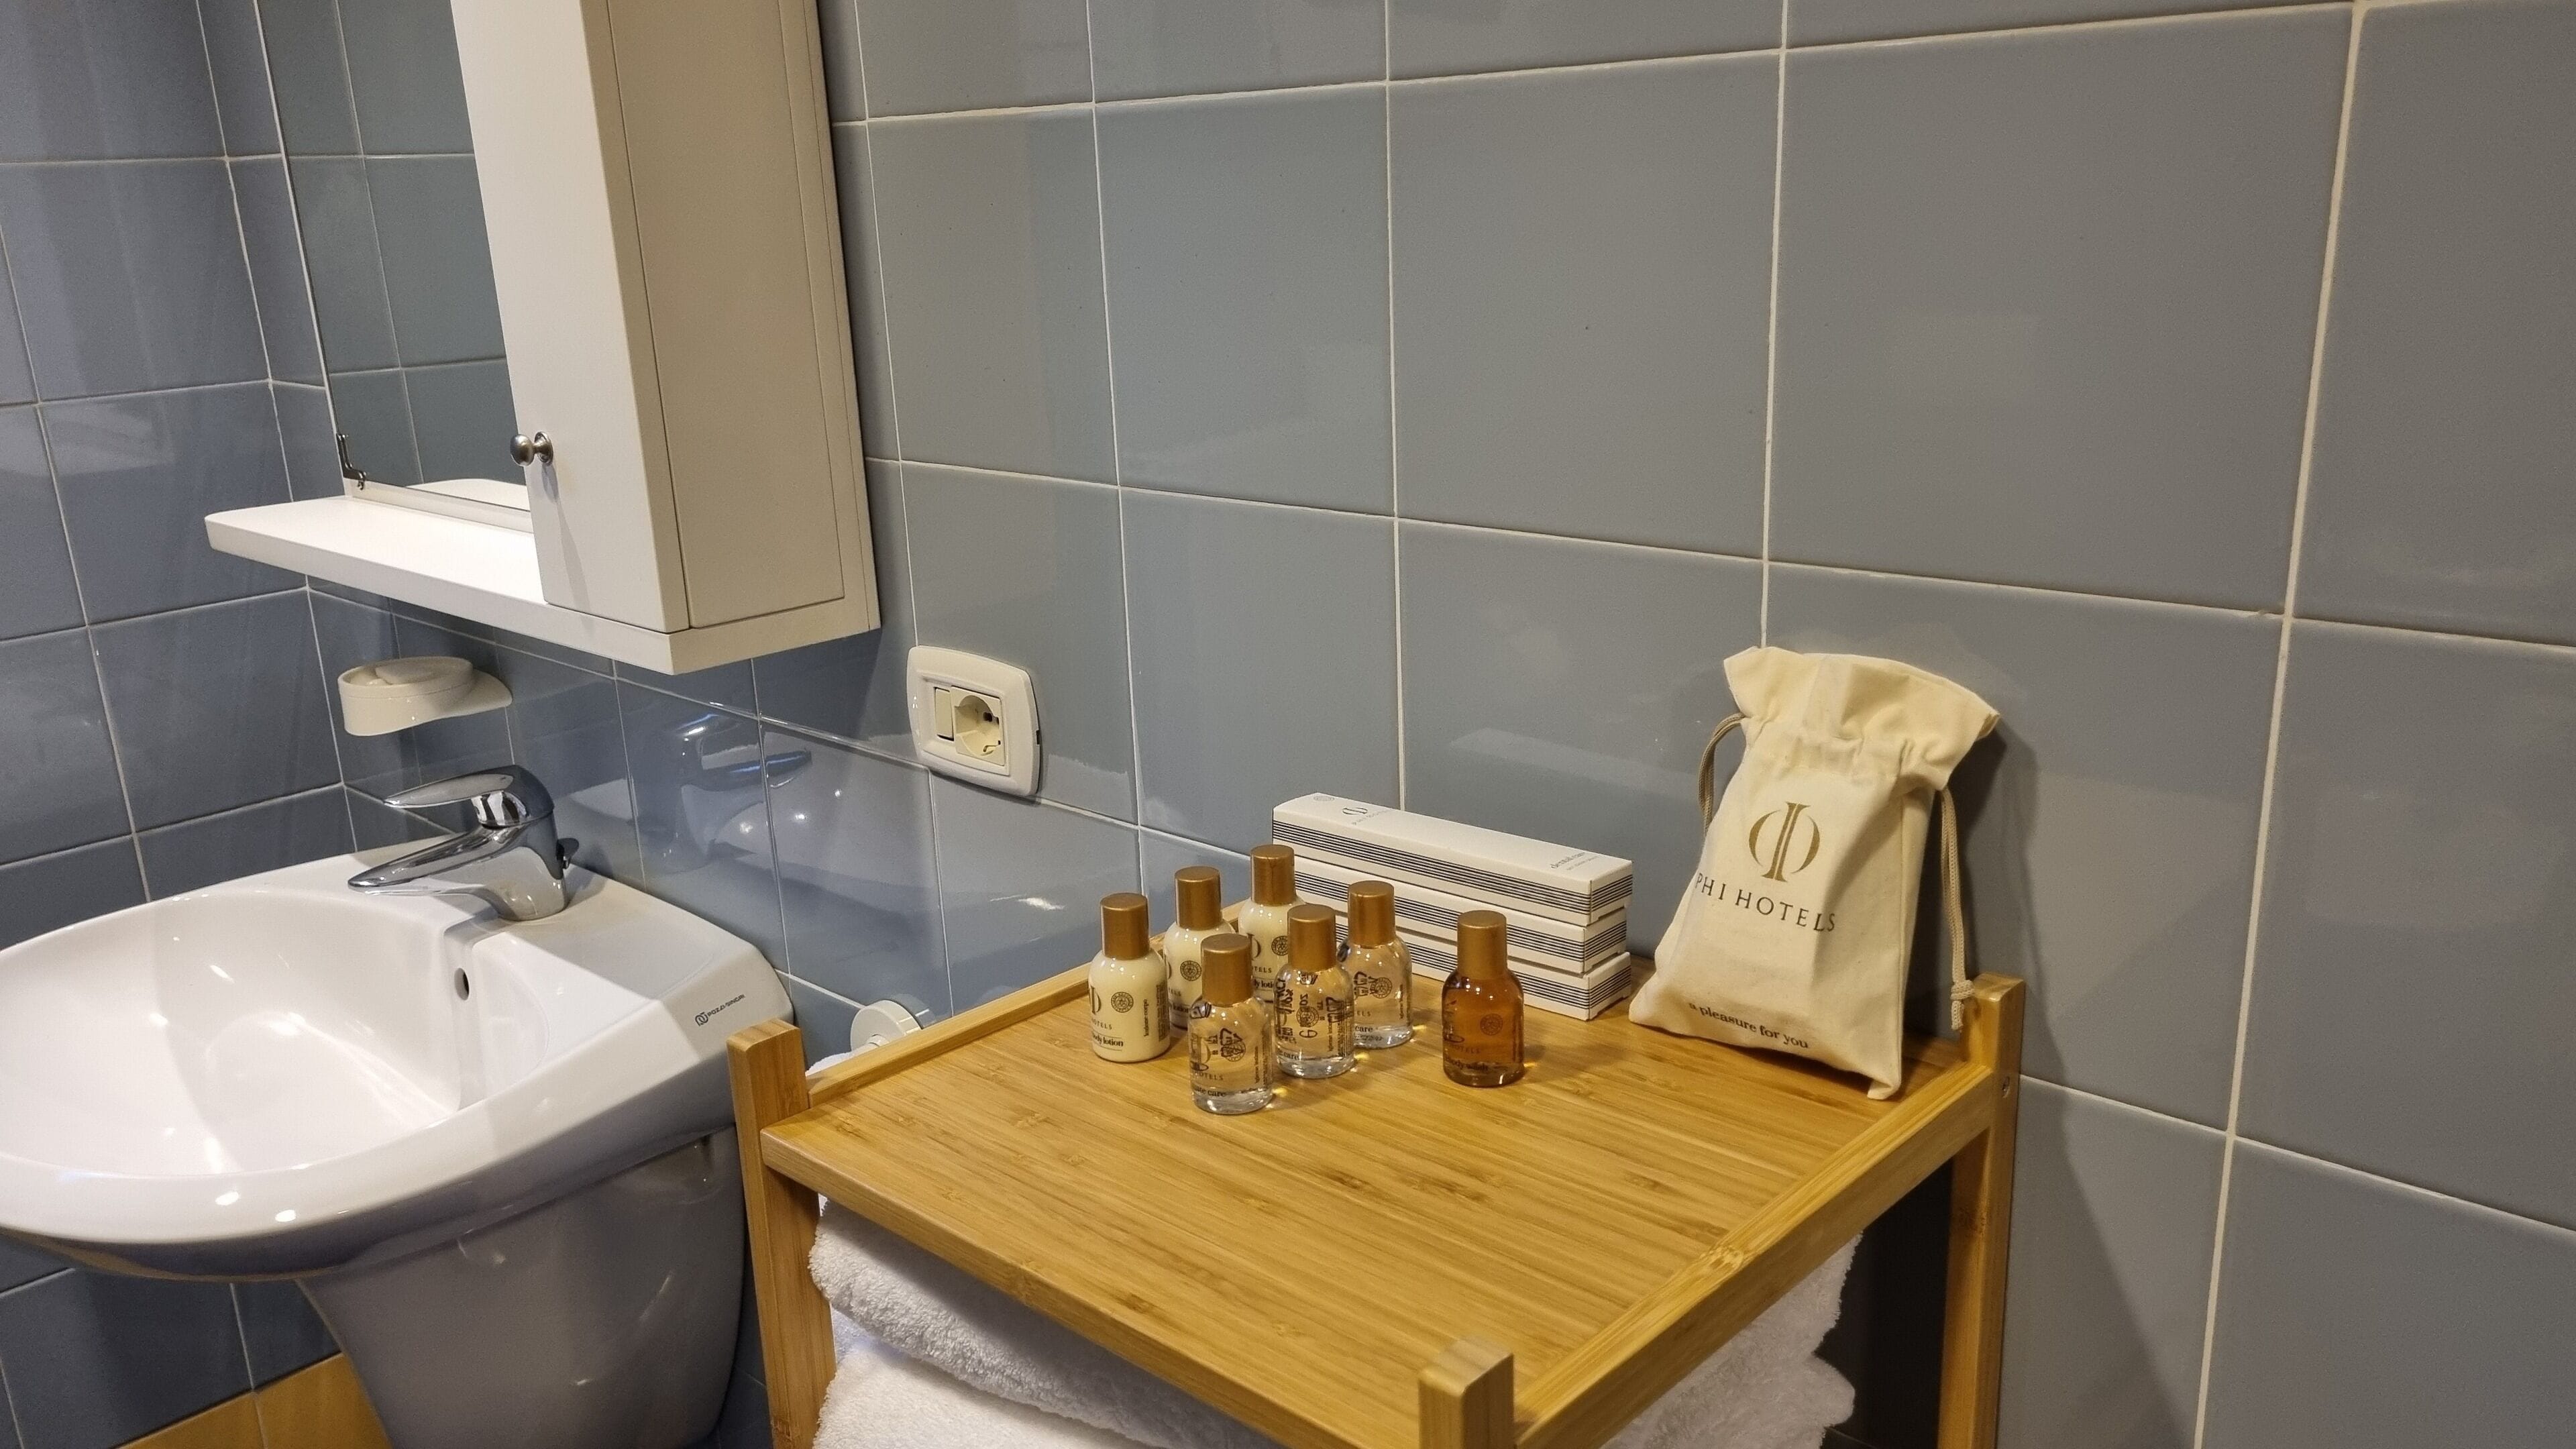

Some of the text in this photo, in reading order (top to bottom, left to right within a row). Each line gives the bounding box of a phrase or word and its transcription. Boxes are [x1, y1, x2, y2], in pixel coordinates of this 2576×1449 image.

[1695, 872, 1835, 932] PHI HOTELS
[1262, 980, 1275, 988] loti
[1699, 1006, 1757, 1032] pleasure
[1760, 1025, 1780, 1039] for
[1783, 1034, 1809, 1049] you
[1104, 1037, 1124, 1046] lotion
